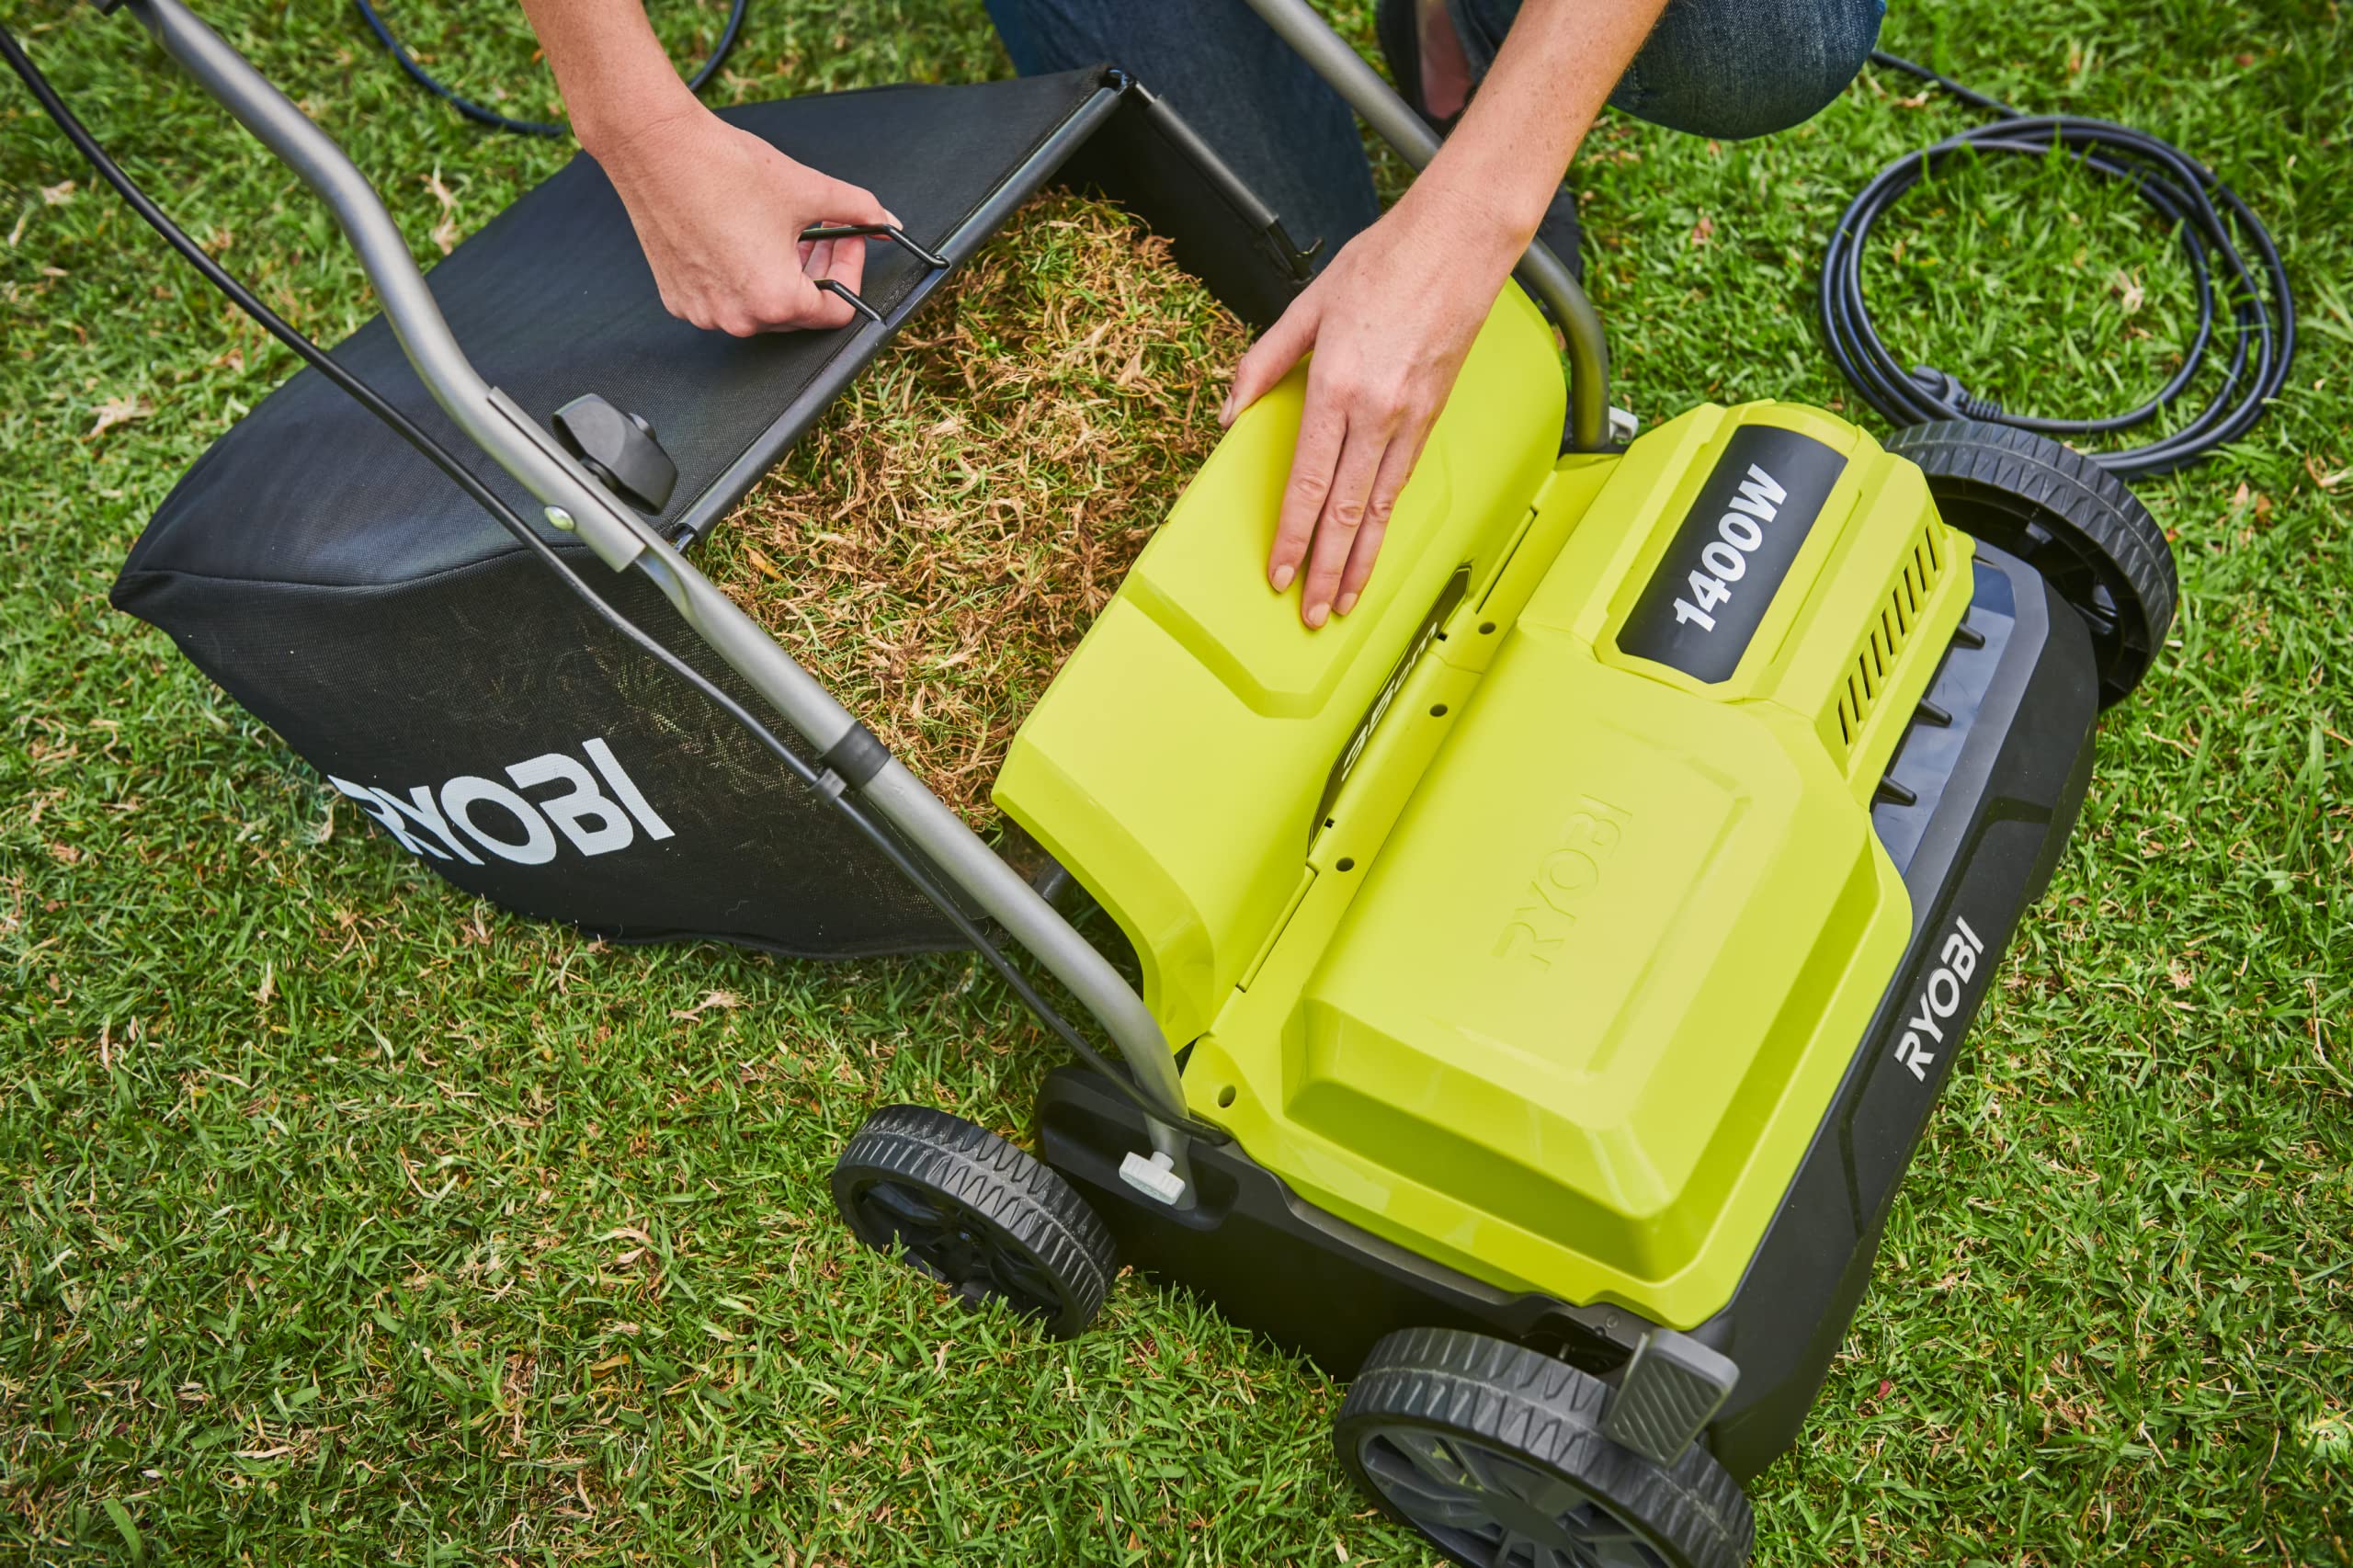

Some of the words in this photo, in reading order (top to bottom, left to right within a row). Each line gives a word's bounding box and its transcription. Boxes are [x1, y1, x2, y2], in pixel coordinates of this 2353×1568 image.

[1673, 463, 1787, 632] 1400W
[1341, 621, 1438, 781] 35cm
[327, 738, 676, 865] RYOBI
[1491, 794, 1632, 973] RYOBI
[1894, 915, 1984, 1083] RYOBI
